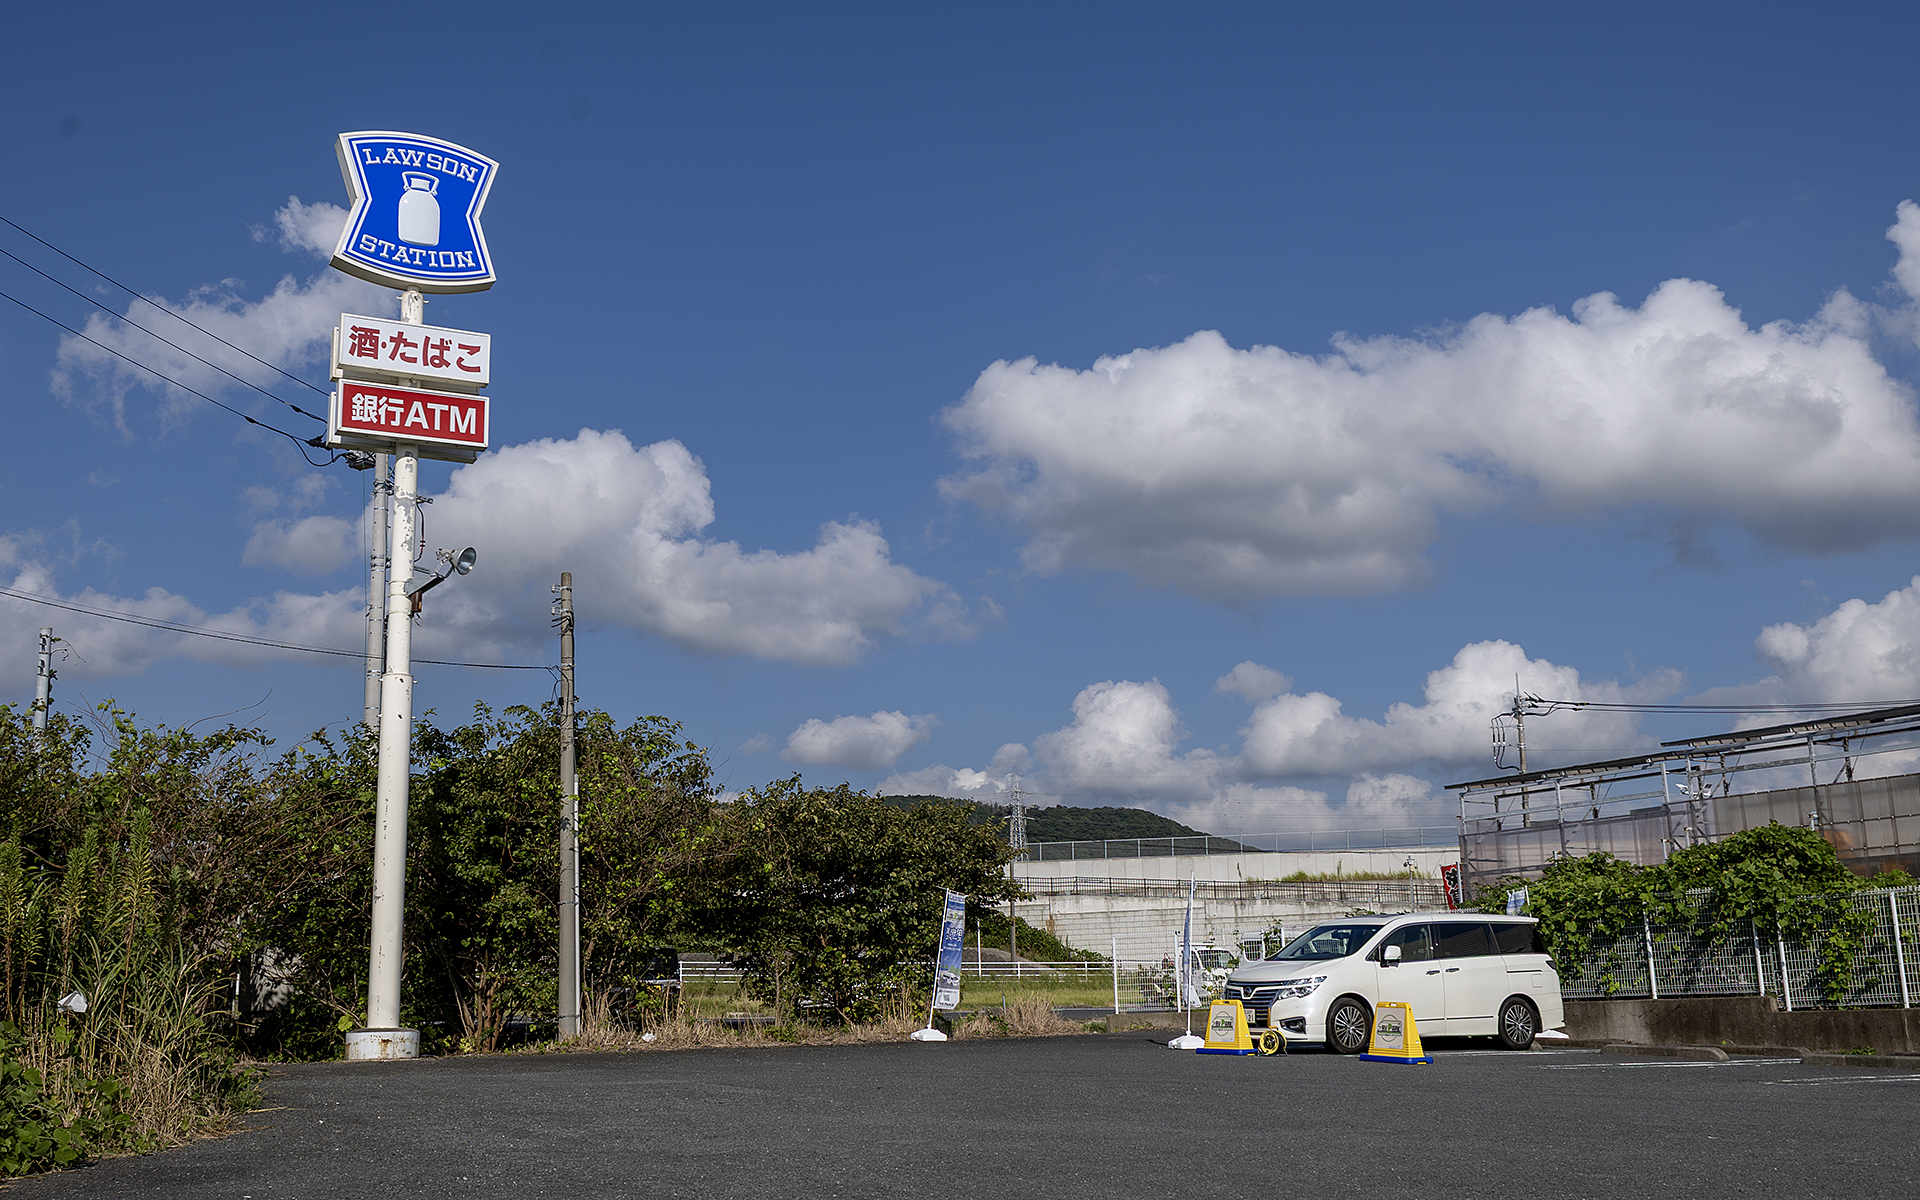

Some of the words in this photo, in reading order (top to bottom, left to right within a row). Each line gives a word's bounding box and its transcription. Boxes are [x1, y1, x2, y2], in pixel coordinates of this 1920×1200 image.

[362, 147, 479, 184] LAWSON
[359, 233, 476, 268] STATION
[348, 324, 482, 373] 酒・たばこ
[351, 392, 477, 435] 銀行ATM
